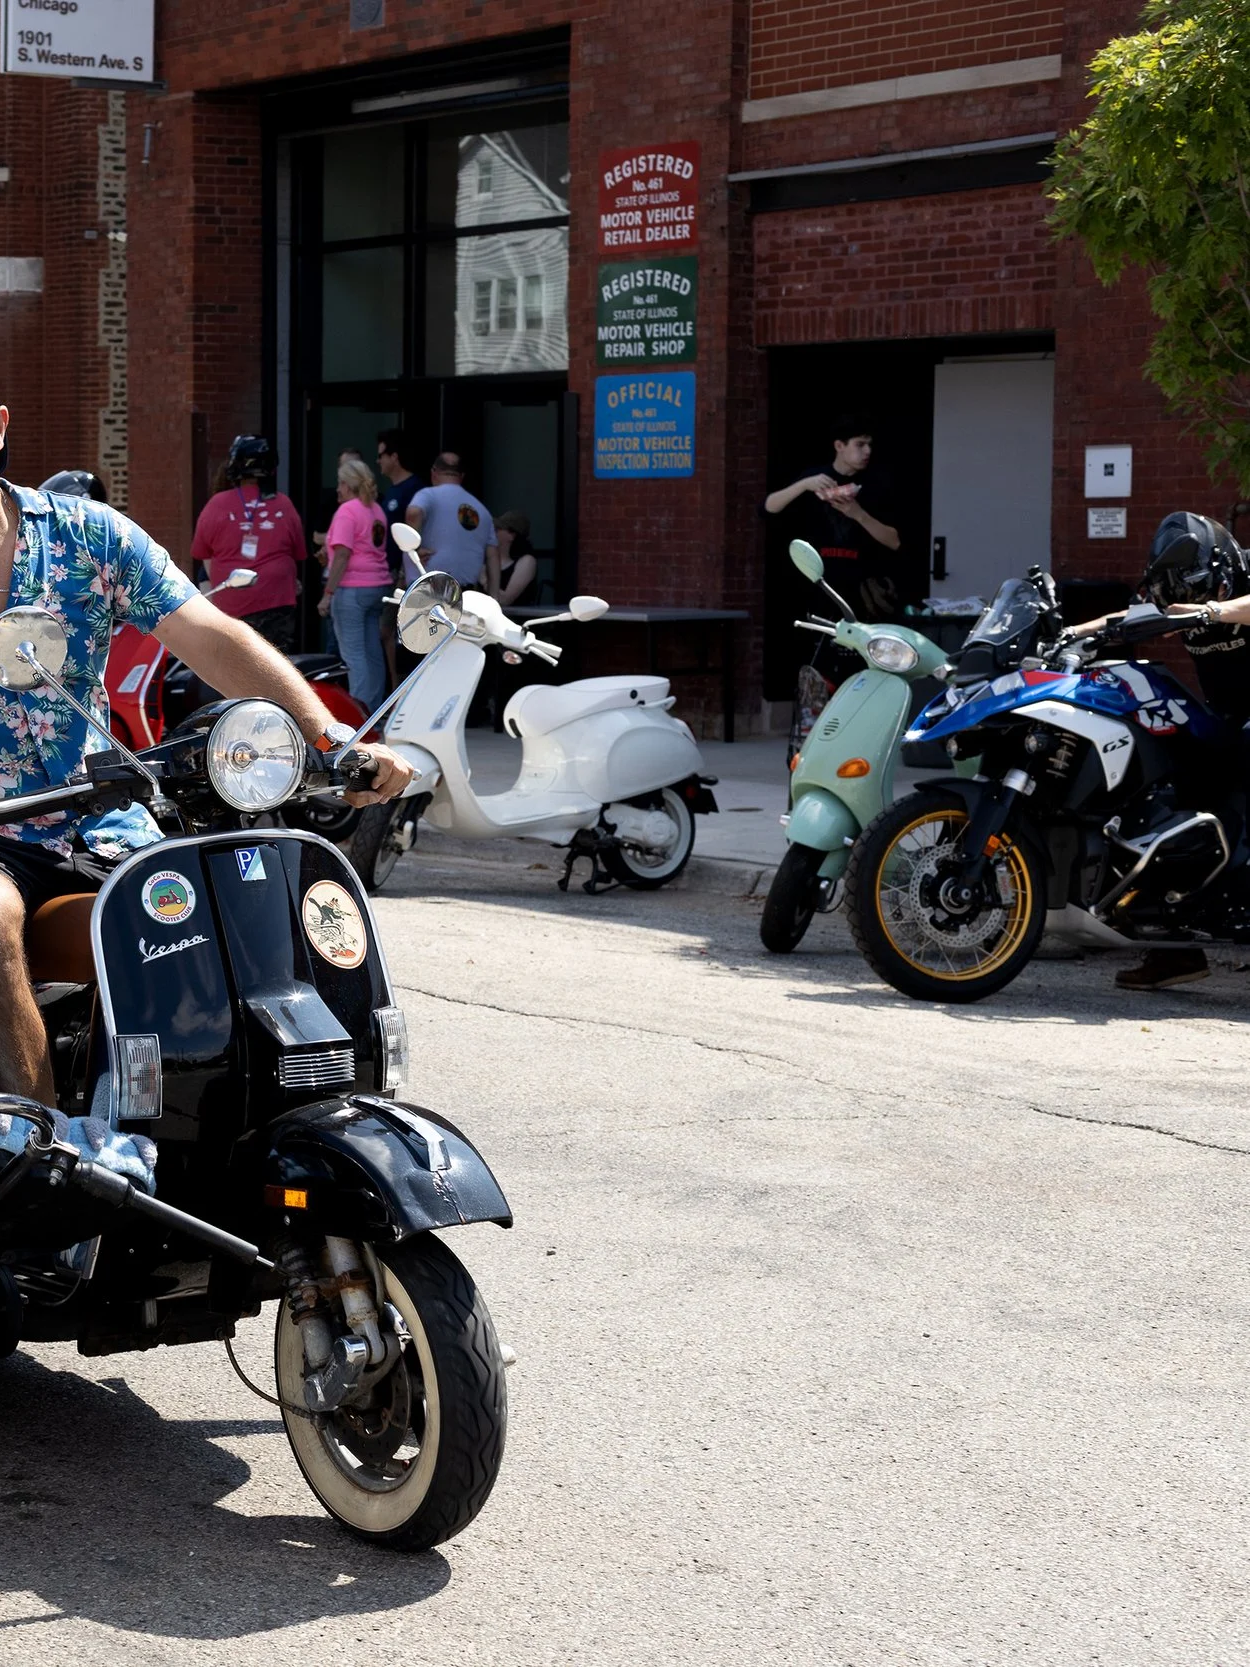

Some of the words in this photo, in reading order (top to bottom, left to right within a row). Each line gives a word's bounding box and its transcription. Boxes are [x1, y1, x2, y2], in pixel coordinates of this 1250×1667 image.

[18, 0, 78, 15] Chicago
[18, 30, 53, 46] 1901
[18, 48, 32, 62] S.
[36, 49, 95, 67] Western
[99, 54, 129, 70] Ave.
[133, 56, 143, 71] S
[604, 154, 693, 189] REGISTERED
[615, 196, 637, 208] STATE
[638, 194, 648, 205] OF
[649, 191, 680, 204] ILLINOIS
[601, 211, 642, 228] MOTOR
[646, 205, 694, 223] VEHICLE
[604, 229, 642, 245] RETAIL
[646, 224, 690, 241] DEALER
[602, 269, 691, 302] REGISTERED
[613, 309, 635, 321] STATE
[636, 308, 647, 319] OF
[648, 306, 678, 319] ILLINOIS
[598, 325, 641, 341] MOTOR
[644, 321, 693, 338] VEHICLE
[605, 342, 645, 358] REPAIR
[651, 340, 685, 355] SHOP
[607, 382, 681, 408] OFFICIAL
[597, 437, 639, 452] MOTOR
[643, 436, 691, 451] VEHICLE
[597, 453, 649, 470] INSPECTION
[652, 453, 691, 469] STATION
[1102, 735, 1129, 753] GS
[238, 851, 252, 870] P
[161, 872, 180, 880] VESPA
[153, 912, 180, 922] SCOOTER
[180, 906, 192, 918] CLUB
[139, 935, 210, 963] Vespa
